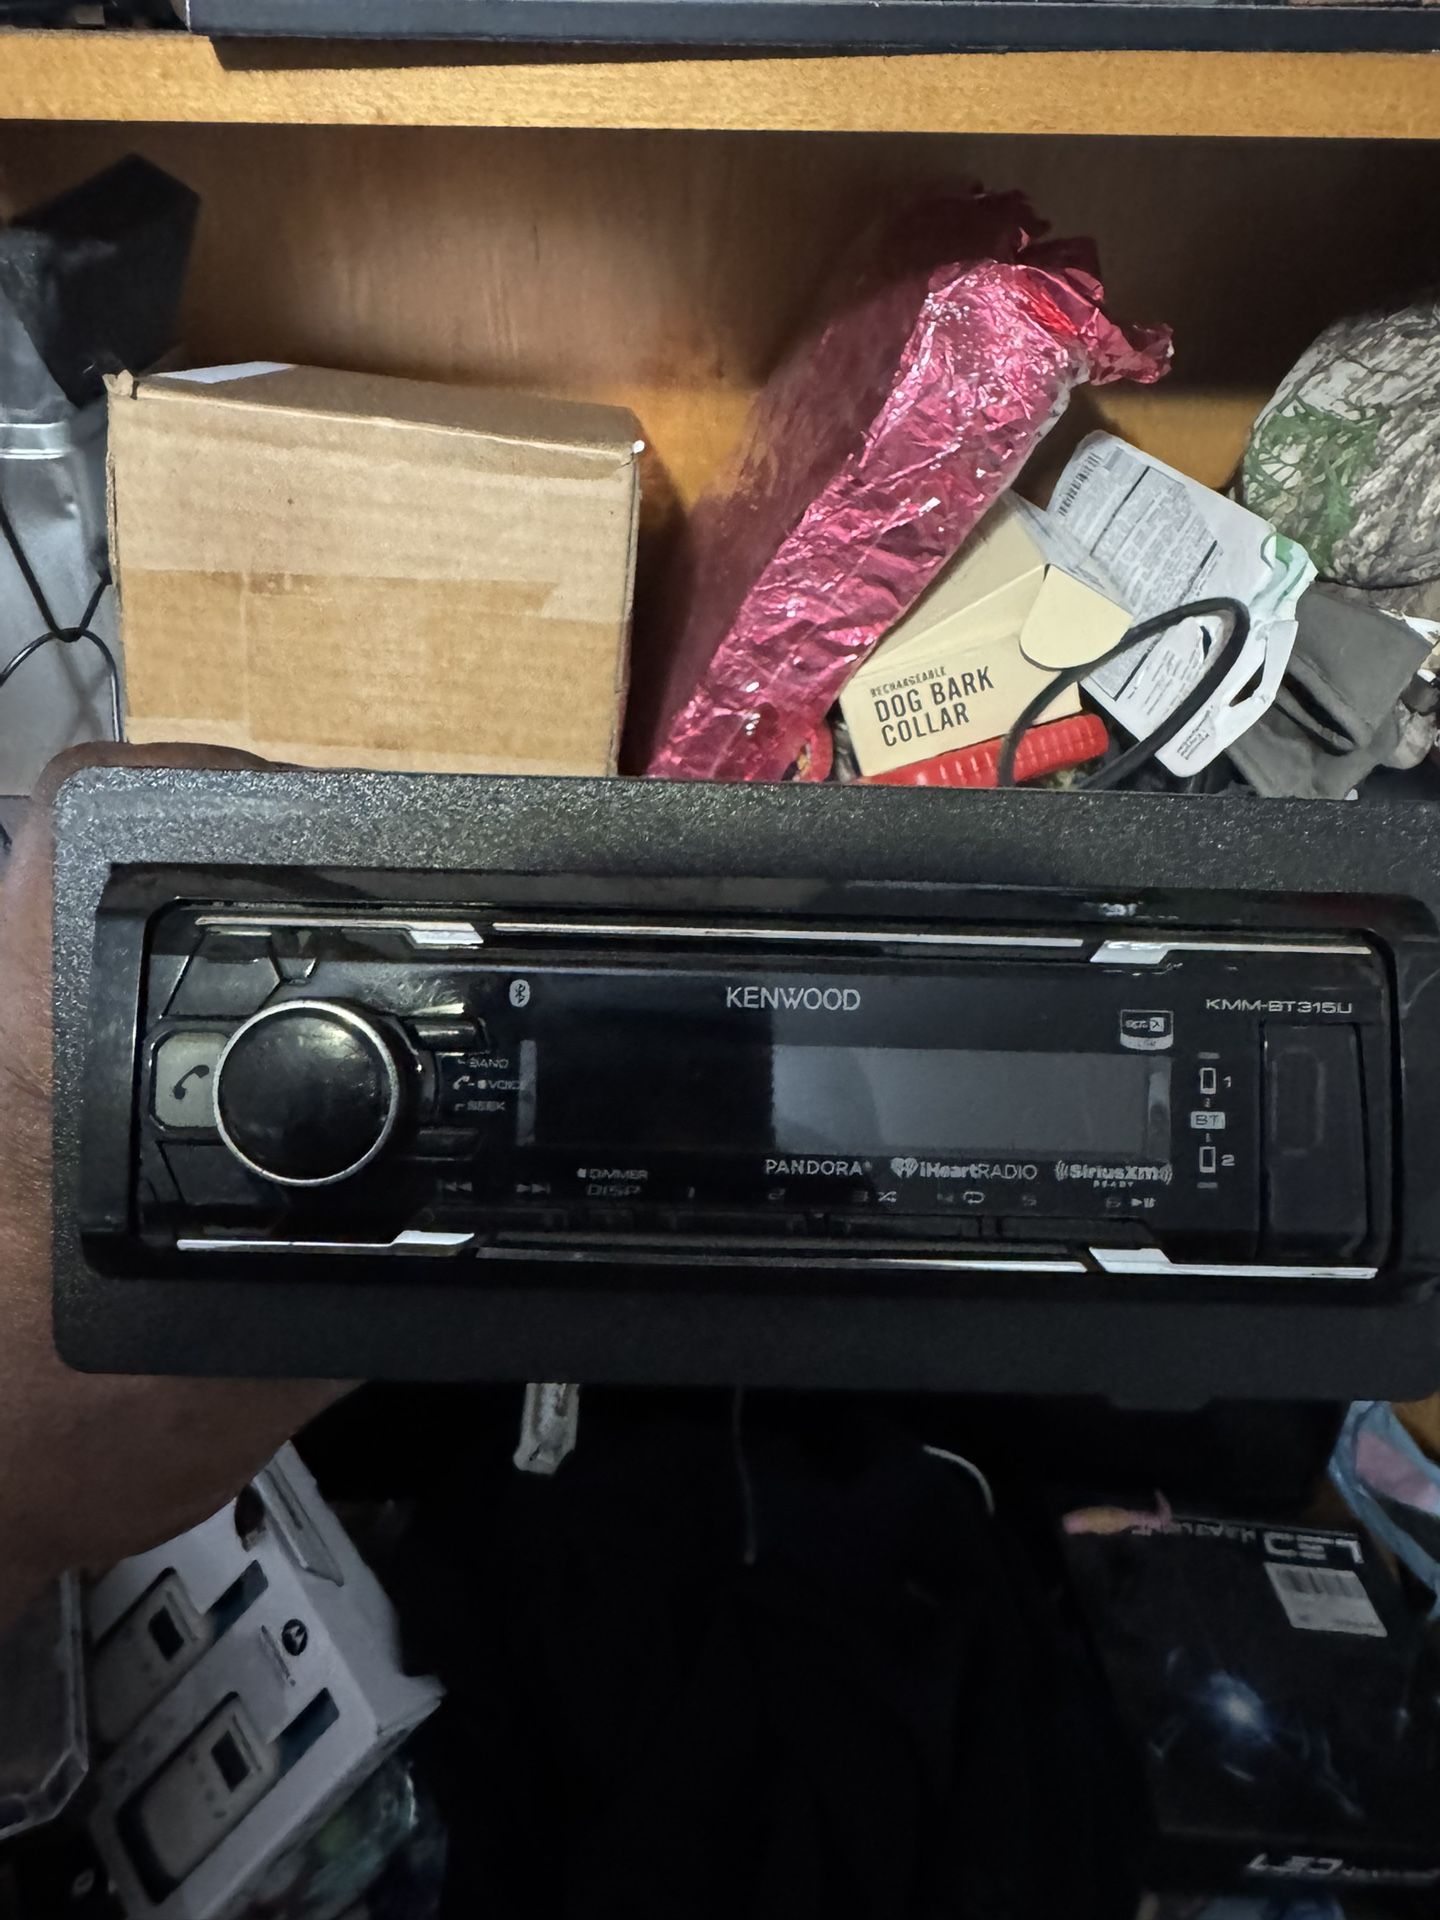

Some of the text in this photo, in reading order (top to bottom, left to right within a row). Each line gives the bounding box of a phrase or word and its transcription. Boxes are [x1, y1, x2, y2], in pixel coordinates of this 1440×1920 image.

[874, 665, 994, 722] DOG BARK
[881, 702, 970, 747] COLLAR
[726, 986, 861, 1010] KENWOOD
[1205, 998, 1353, 1015] KMM-BT315U
[1222, 1075, 1232, 1089] 1
[765, 1158, 864, 1177] PANDORA
[1221, 1154, 1236, 1167] 2
[1263, 1531, 1365, 1565] LED
